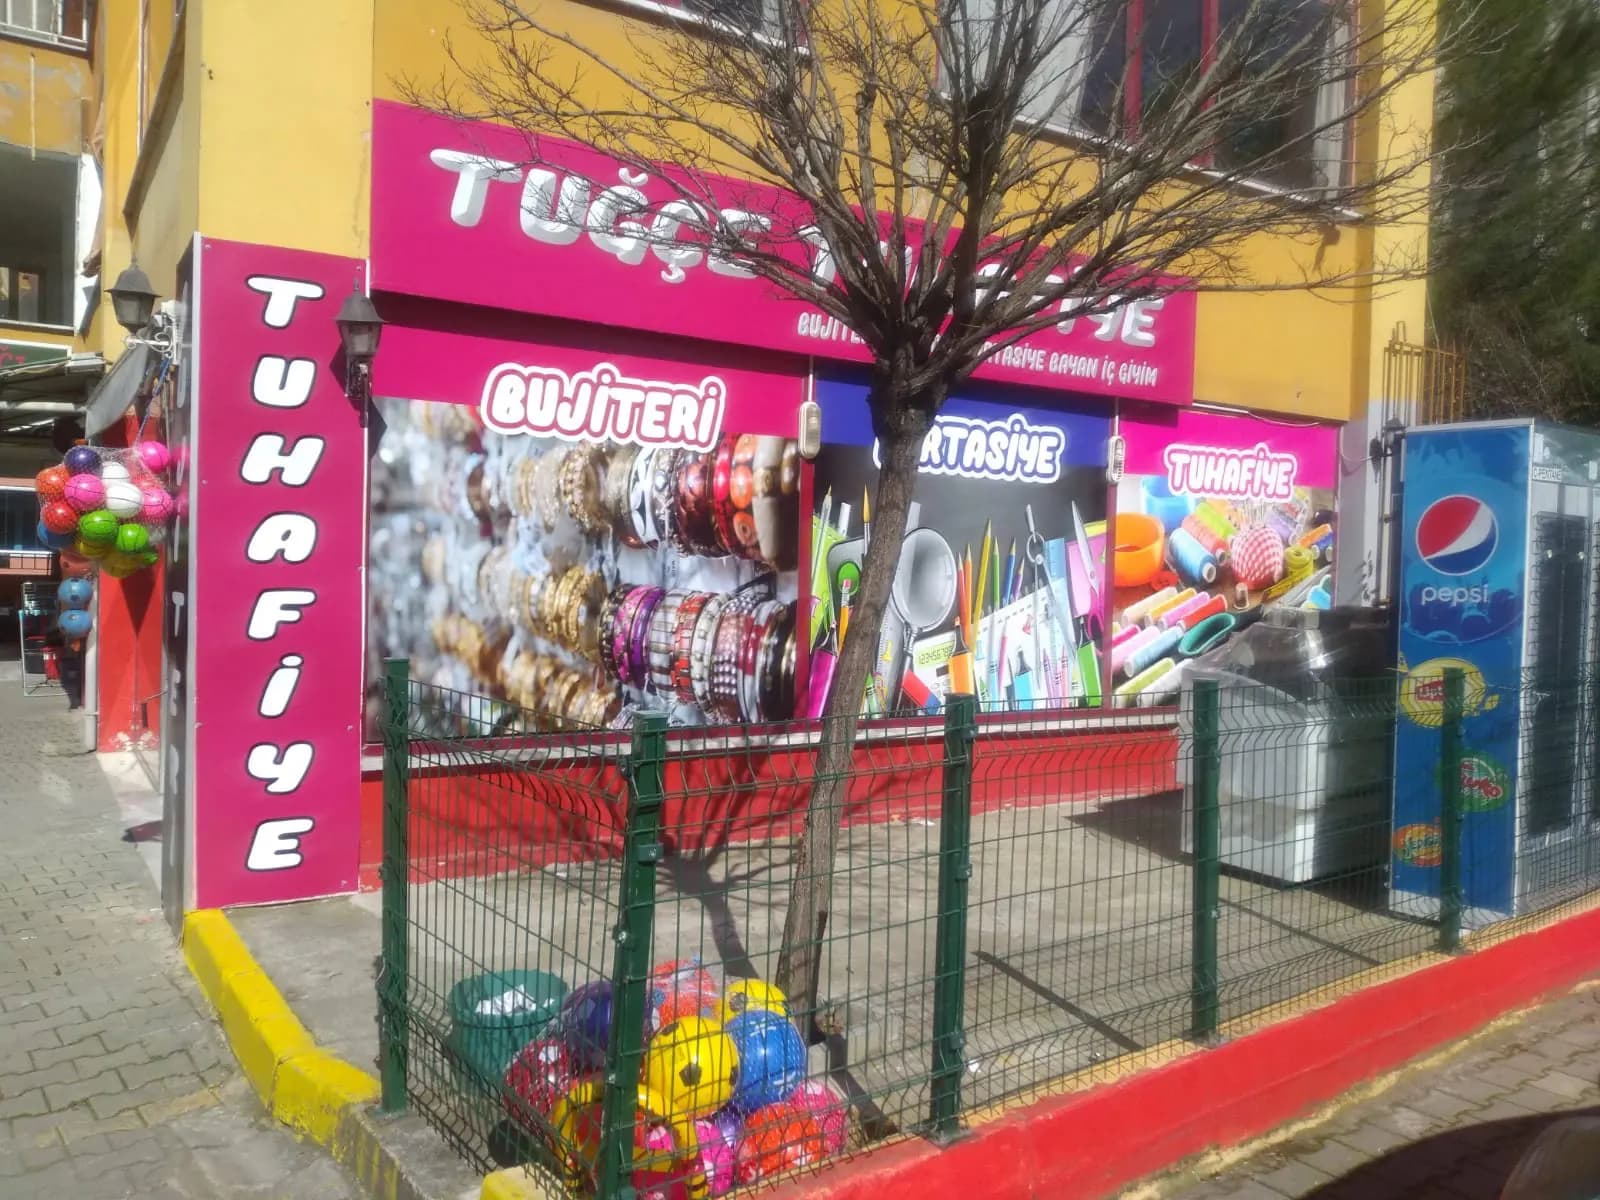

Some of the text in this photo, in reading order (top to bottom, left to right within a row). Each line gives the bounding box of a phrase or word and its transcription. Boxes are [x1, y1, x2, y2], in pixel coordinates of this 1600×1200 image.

[430, 148, 772, 284] TUĞÇE
[1049, 351, 1099, 378] BAYAN
[1101, 355, 1116, 386] İÇ
[1118, 359, 1158, 387] GİYİM
[485, 365, 723, 449] BUJİTERİ
[905, 416, 1063, 481] RTASİYE
[1165, 444, 1296, 500] TUHAFİYE
[242, 275, 325, 871] TUHAFİYE
[1421, 583, 1489, 606] pepsi
[1418, 684, 1444, 700] Lipt
